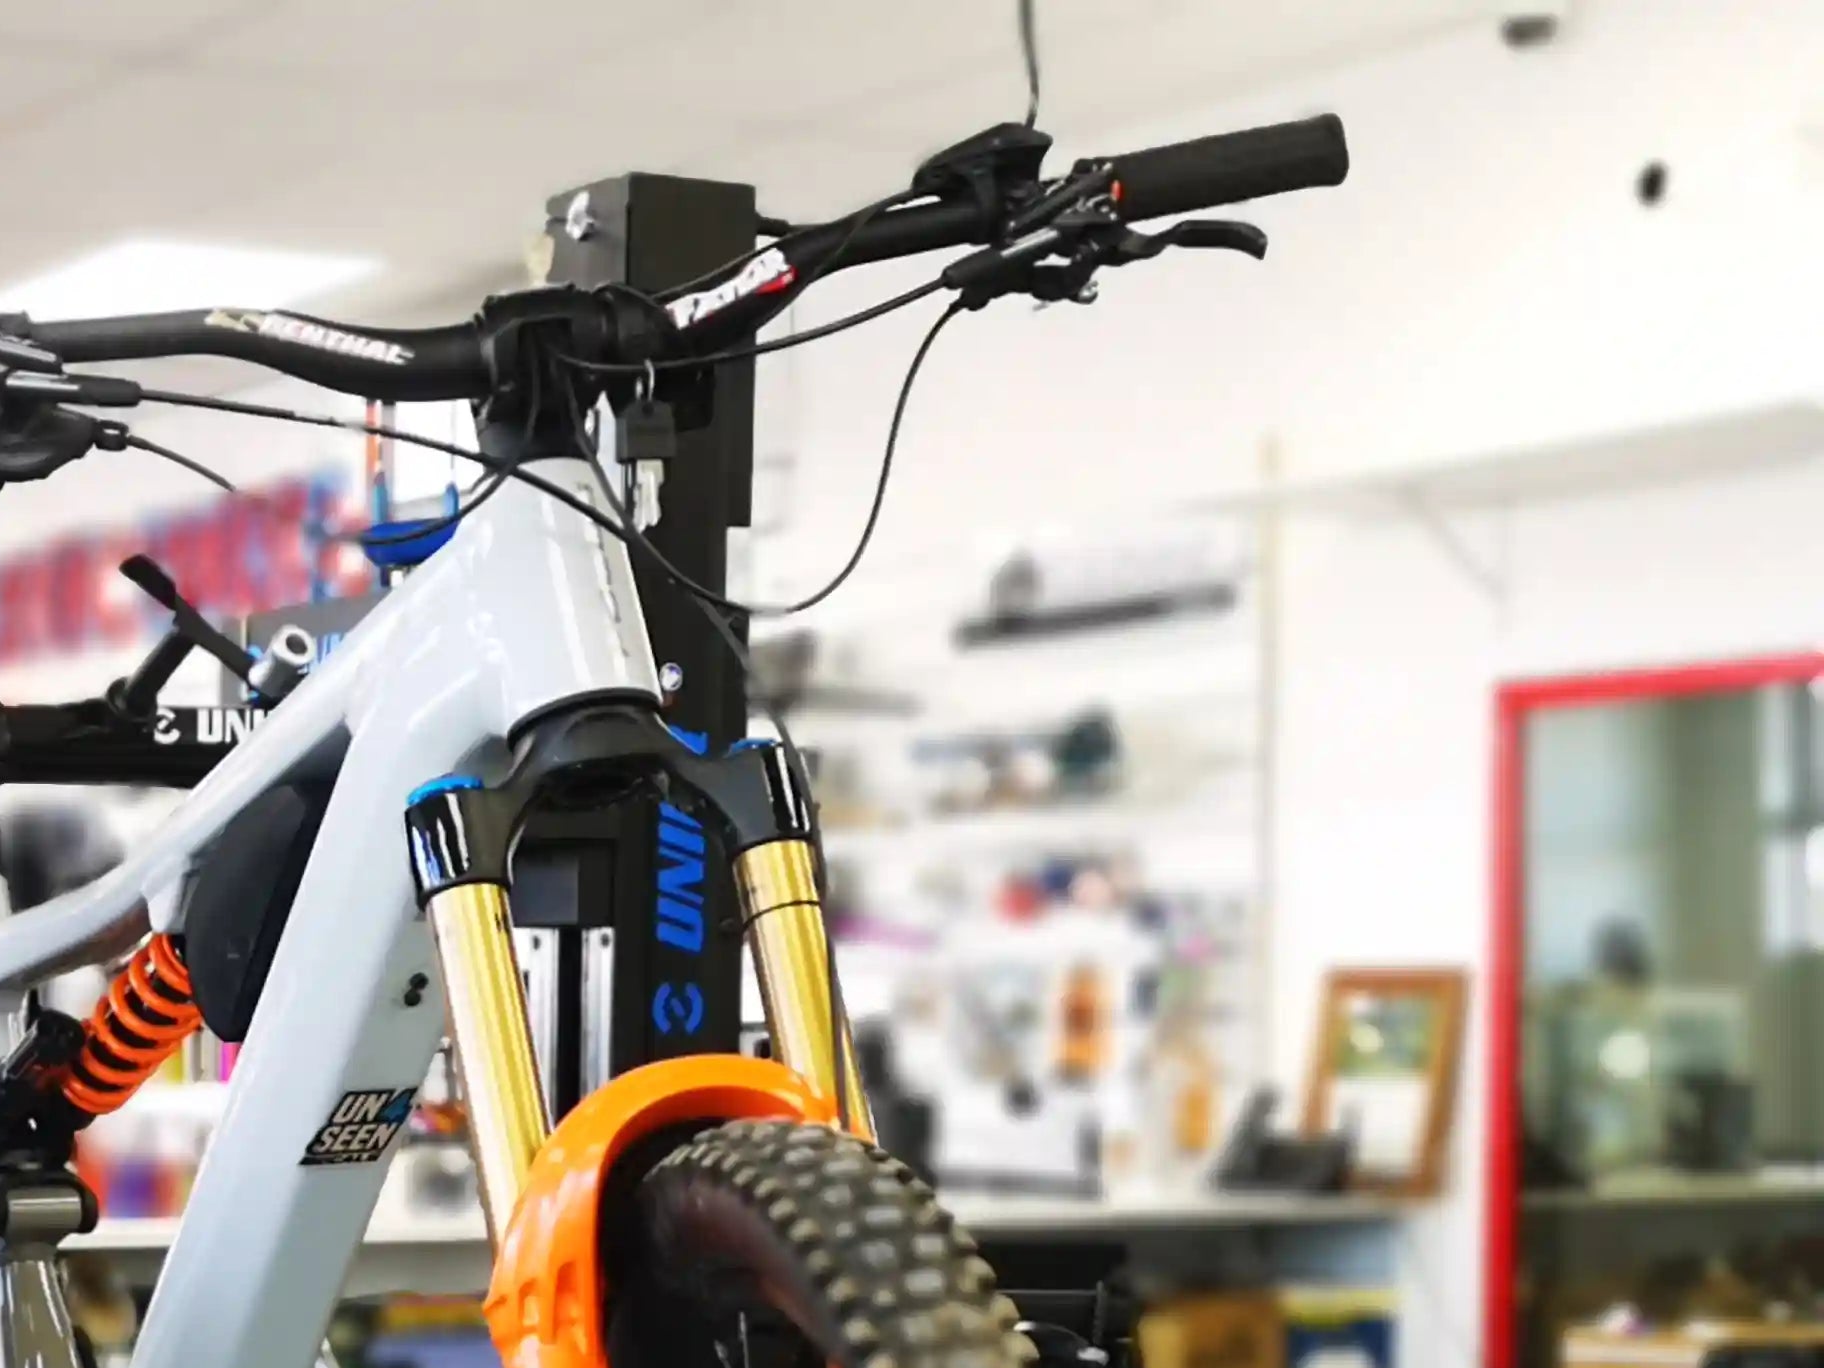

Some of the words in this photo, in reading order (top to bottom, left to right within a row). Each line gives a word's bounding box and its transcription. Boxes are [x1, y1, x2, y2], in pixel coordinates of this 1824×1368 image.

[196, 708, 270, 744] UNI
[332, 1093, 389, 1123] UN
[312, 1122, 399, 1153] SEEN
